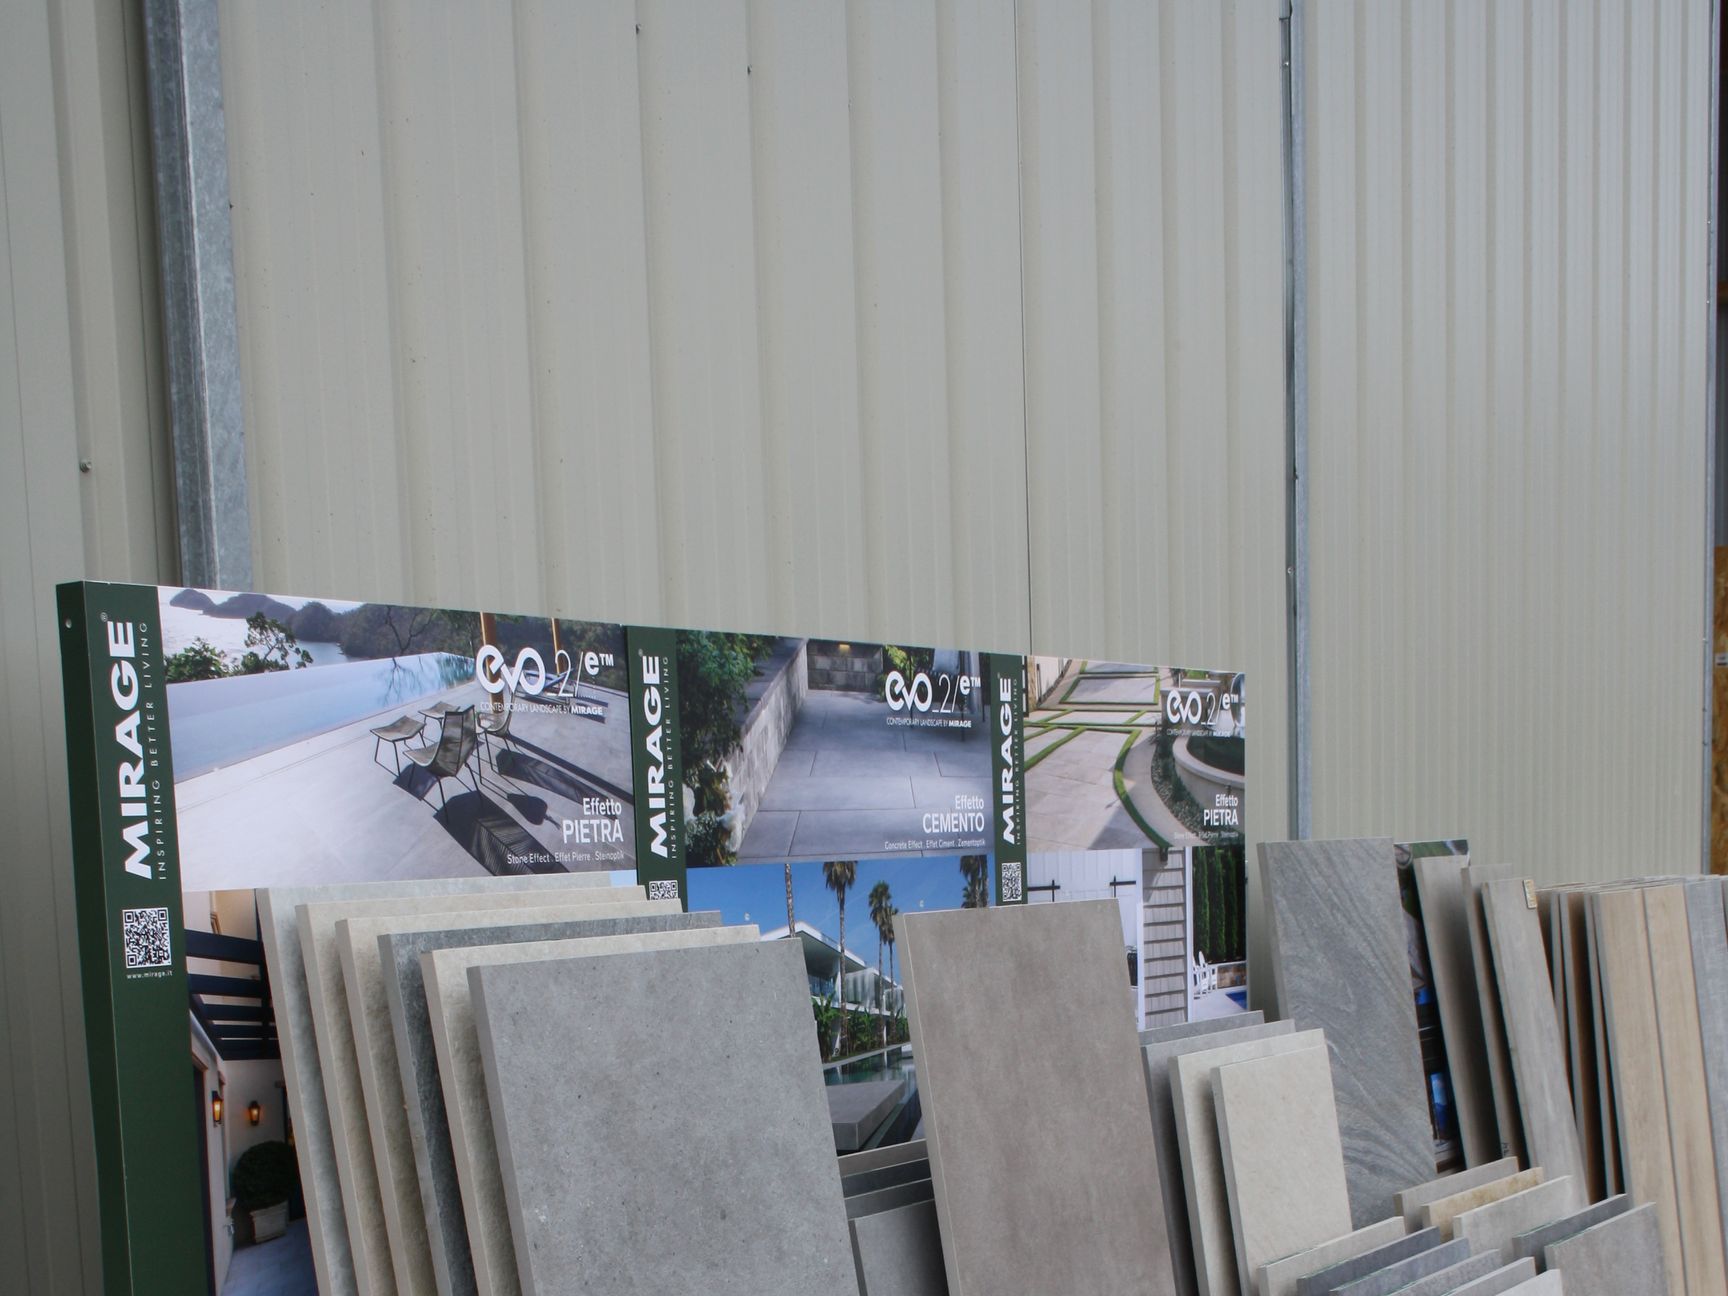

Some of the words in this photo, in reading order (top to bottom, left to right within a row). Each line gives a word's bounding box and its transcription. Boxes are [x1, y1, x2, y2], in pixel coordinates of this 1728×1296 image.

[139, 623, 153, 688] LIVING
[571, 706, 603, 716] MIRAGE
[948, 720, 972, 729] MIRAGE
[146, 702, 159, 767] BETTER
[107, 621, 152, 880] MIRAGE
[642, 655, 668, 858] MIRAGE
[1000, 677, 1015, 845] MIRAGE
[583, 797, 622, 815] Effetto
[955, 795, 985, 810] Effetto
[1215, 793, 1239, 807] Effetto
[922, 812, 985, 833] CEMENTO
[1203, 809, 1239, 826] PIETRA
[152, 780, 167, 880] INSPIRING
[562, 819, 624, 844] PIETRA
[507, 854, 528, 865] Stone
[529, 853, 550, 864] Effect
[554, 852, 571, 862] Effet
[572, 851, 591, 862] Pierre
[127, 970, 173, 980] www.mirage.it
